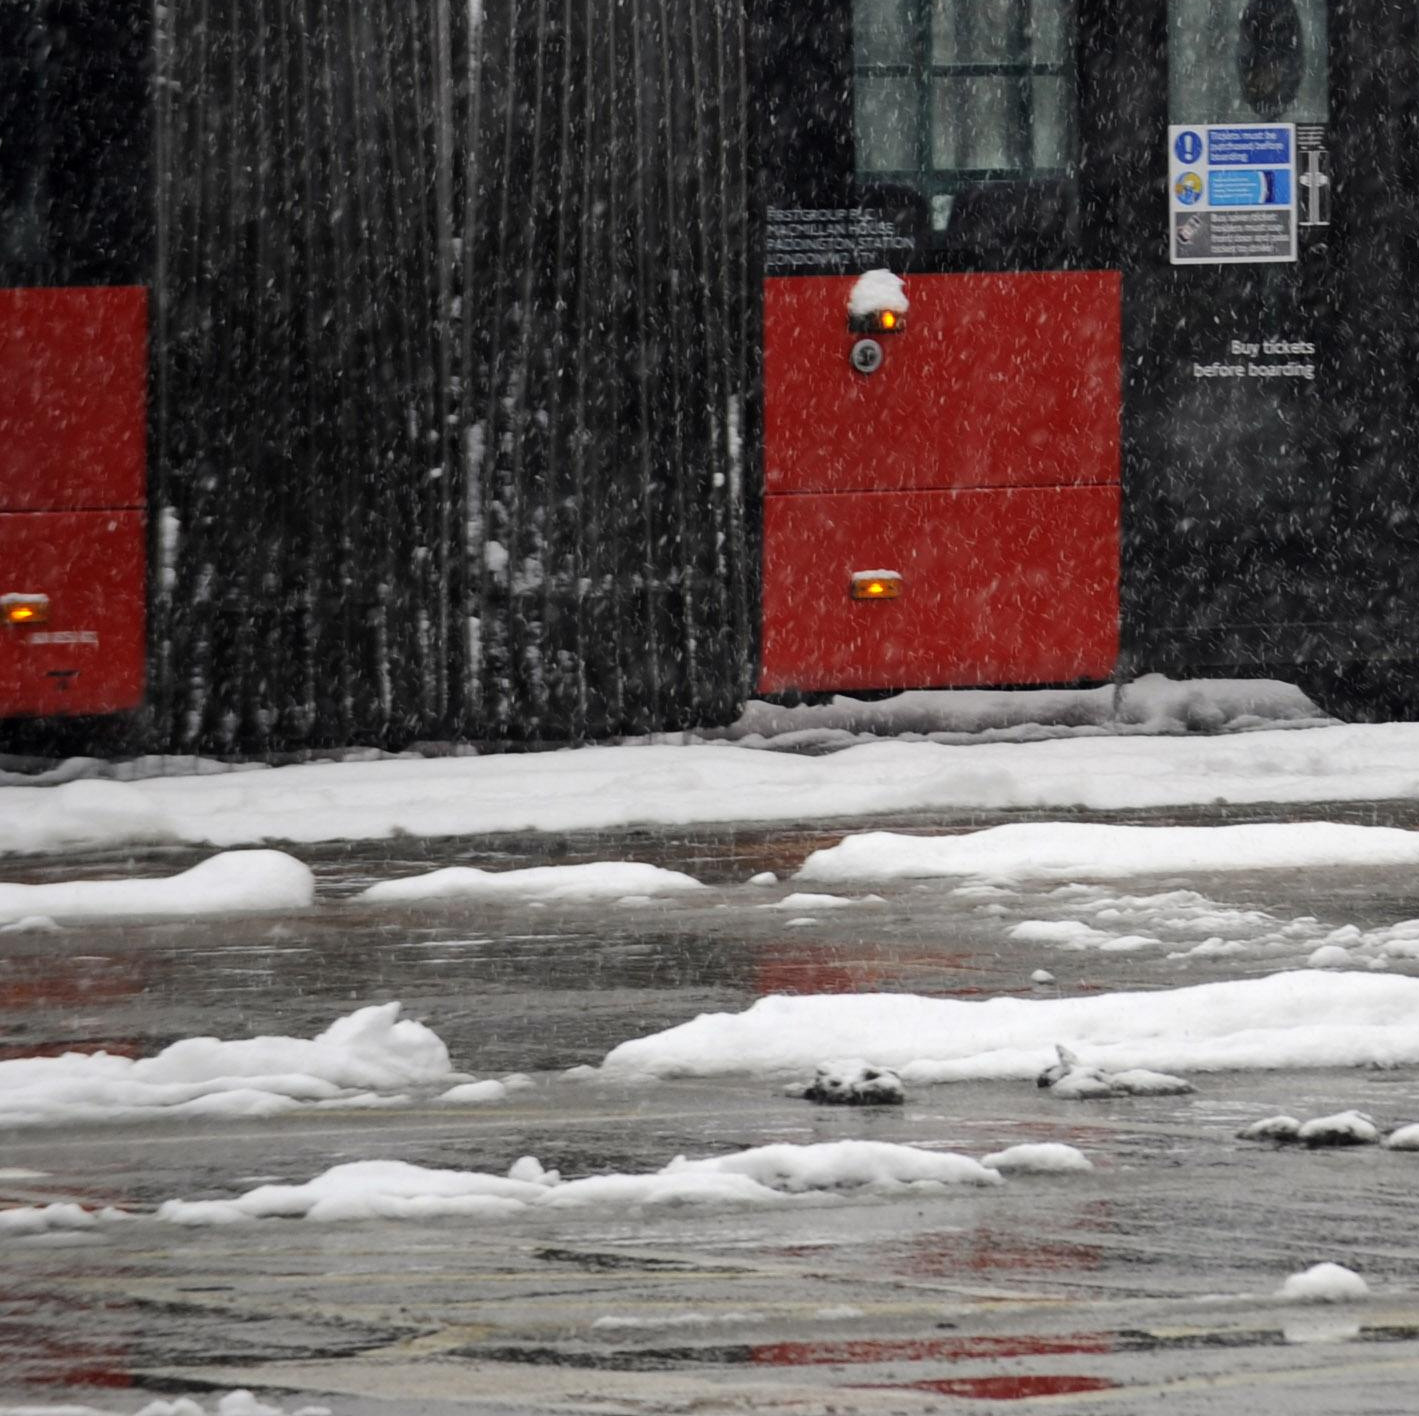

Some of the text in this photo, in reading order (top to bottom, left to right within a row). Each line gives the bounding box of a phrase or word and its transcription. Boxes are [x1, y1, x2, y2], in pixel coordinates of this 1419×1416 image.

[1231, 340, 1315, 358] Buy tickets
[1193, 361, 1315, 379] before boarding
